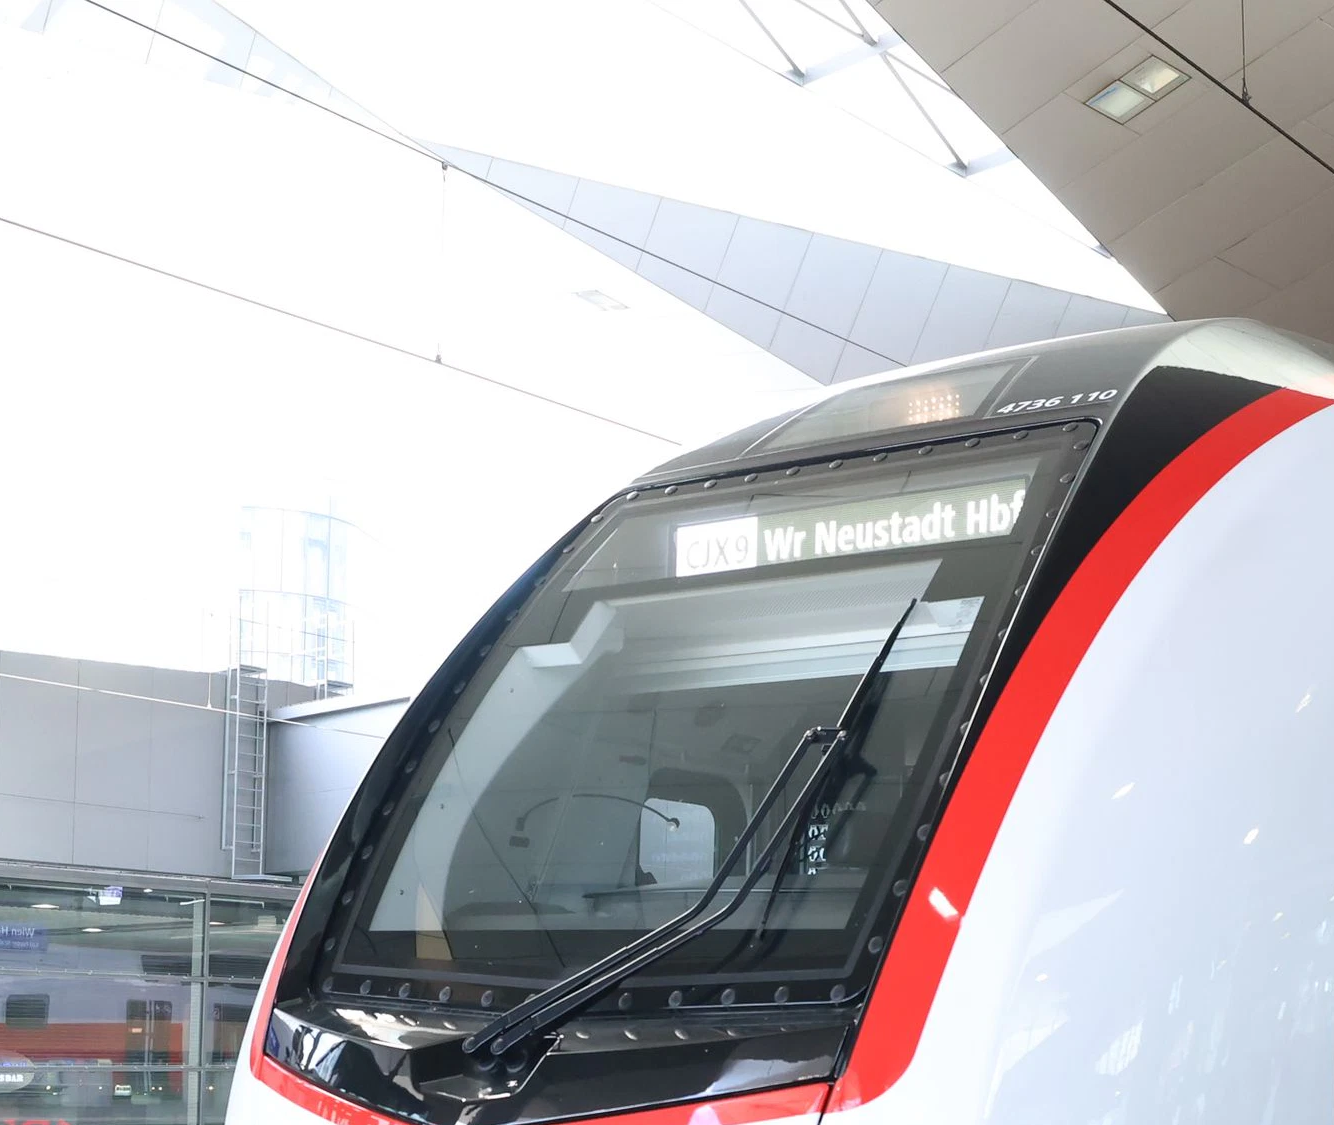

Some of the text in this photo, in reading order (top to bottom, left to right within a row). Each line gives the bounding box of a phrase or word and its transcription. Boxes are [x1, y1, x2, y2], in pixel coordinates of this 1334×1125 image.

[996, 389, 1118, 415] 4736 110
[764, 525, 806, 562] Wr
[814, 501, 956, 555] Neustadt
